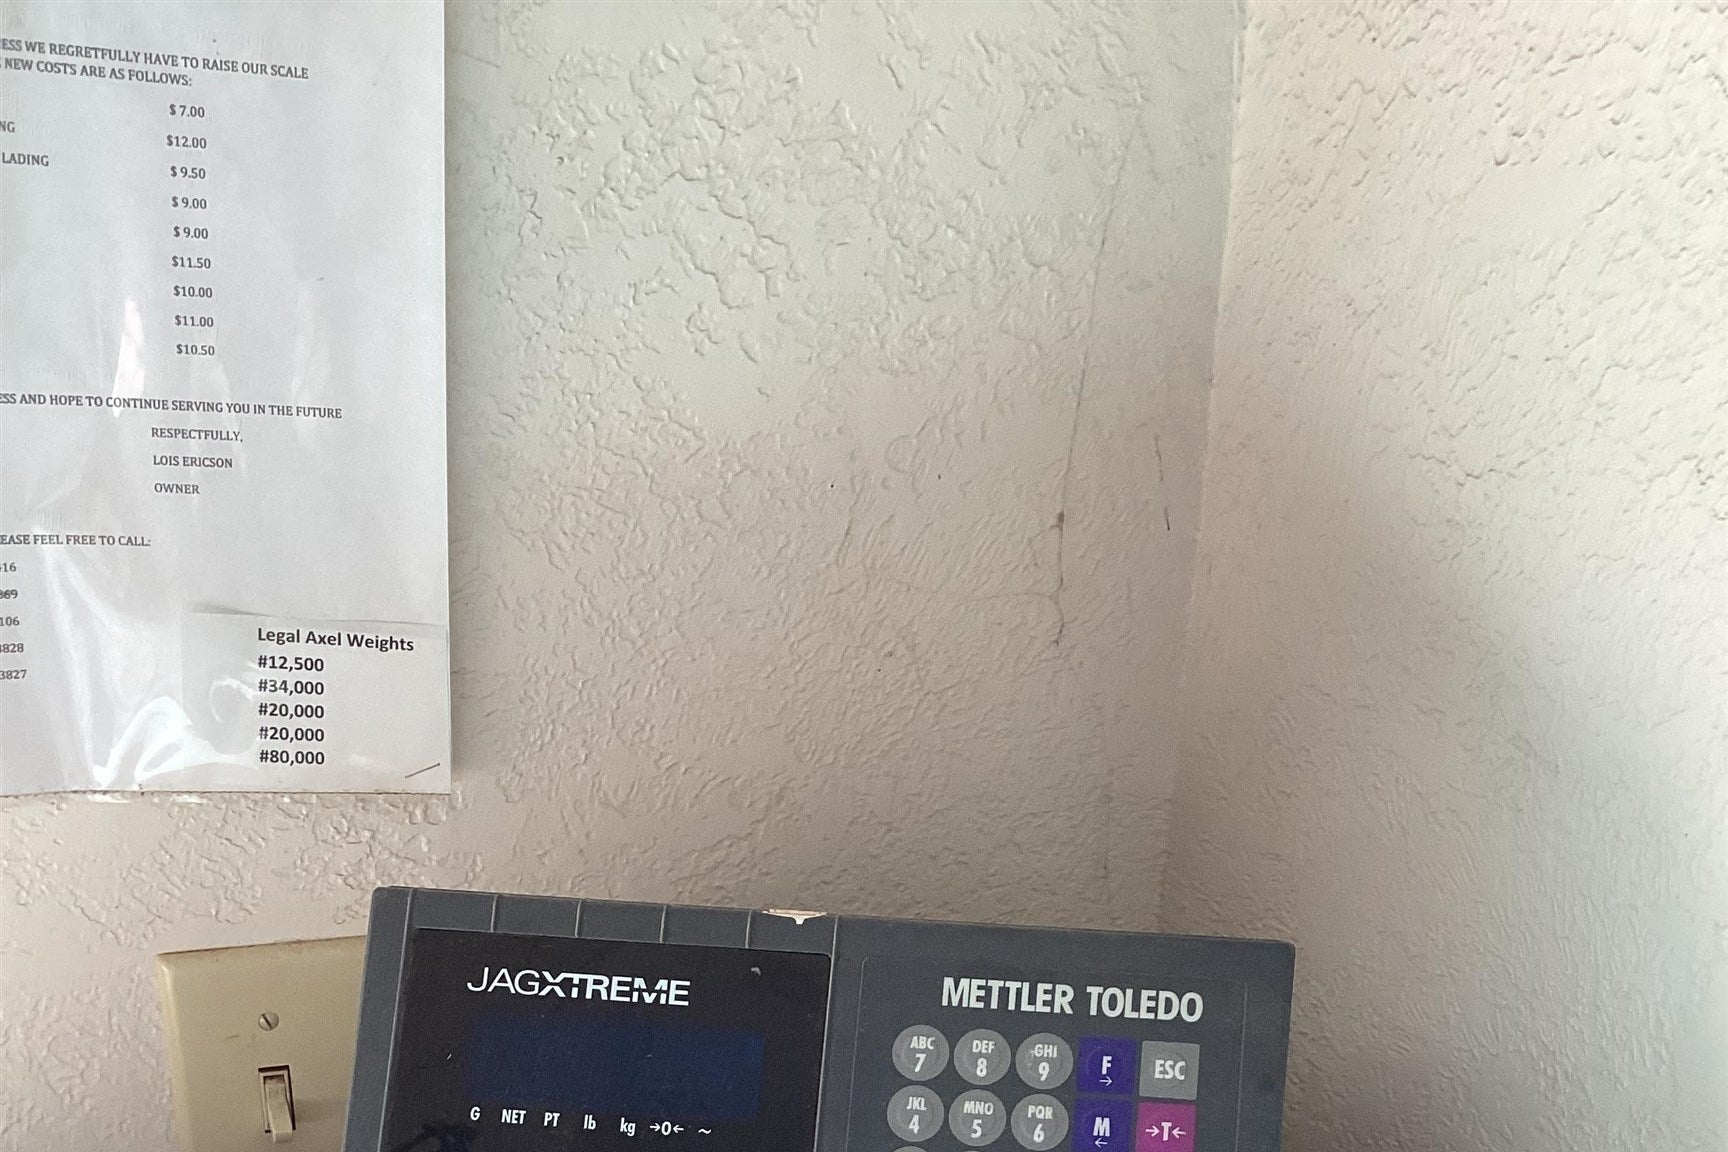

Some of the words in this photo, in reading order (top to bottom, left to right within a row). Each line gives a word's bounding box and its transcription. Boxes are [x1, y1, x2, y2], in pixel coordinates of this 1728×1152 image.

[25, 41, 45, 53] WE
[49, 43, 140, 63] REGRETFULLY
[144, 53, 178, 66] HAVE
[182, 56, 199, 69] TO
[202, 58, 239, 72] RAISE
[242, 62, 268, 75] OUR
[271, 65, 309, 79] SCALE
[5, 58, 33, 71] NEW
[36, 61, 77, 75] COSTS
[80, 65, 106, 78] ARE
[109, 68, 125, 80] AS
[129, 69, 192, 87] FOLLOWS:
[167, 134, 207, 149] $12.00
[2, 152, 49, 167] LADING
[172, 256, 211, 270] $11.50
[173, 286, 213, 299] $10.00
[174, 315, 214, 329] $11.00
[176, 343, 215, 357] $10.50
[19, 394, 46, 405] AND
[50, 395, 83, 406] HOPE
[85, 396, 103, 407] TO
[106, 397, 169, 410] CONTINUE
[171, 400, 223, 413] SERVING
[226, 403, 250, 414] YOU
[254, 404, 266, 415] IN
[268, 405, 293, 416] THE
[296, 406, 342, 419] FUTURE
[151, 427, 243, 443] RESPECTFULLY,
[153, 455, 180, 467] LOIS
[182, 456, 233, 468] ERICSON
[154, 483, 200, 495] OWNER
[33, 535, 63, 545] FEEL
[66, 535, 97, 546] FREE
[99, 536, 116, 546] TO
[118, 536, 151, 547] CALL:
[258, 628, 300, 645] Legal
[305, 631, 342, 646] Axel
[347, 633, 414, 652] Weights
[258, 655, 325, 672] #12,500
[258, 679, 325, 696] #34,000
[258, 702, 325, 720] #20,000
[259, 726, 325, 743] #20,000
[259, 749, 325, 766] #80,000
[467, 967, 691, 1007] JAGXTREME
[941, 976, 1074, 1014] METTLER
[1086, 985, 1204, 1023] TOLEDO
[910, 1035, 936, 1050] ABC
[972, 1039, 995, 1055] DEF
[1033, 1044, 1058, 1059] GHI
[914, 1053, 926, 1073] 7
[976, 1057, 988, 1077] 8
[1038, 1062, 1049, 1081] 9
[1101, 1055, 1113, 1075] F
[1154, 1059, 1186, 1081] ESC
[906, 1096, 927, 1112] JKL
[963, 1101, 994, 1116] MNO
[470, 1106, 481, 1122] G
[501, 1109, 526, 1125] NET
[543, 1112, 560, 1127] PT
[583, 1114, 597, 1130] lb
[620, 1118, 636, 1137] kg
[1027, 1105, 1054, 1121] PQR
[908, 1115, 920, 1134] 4
[971, 1119, 983, 1139] 5
[1033, 1123, 1045, 1143] 6
[1093, 1117, 1111, 1137] M
